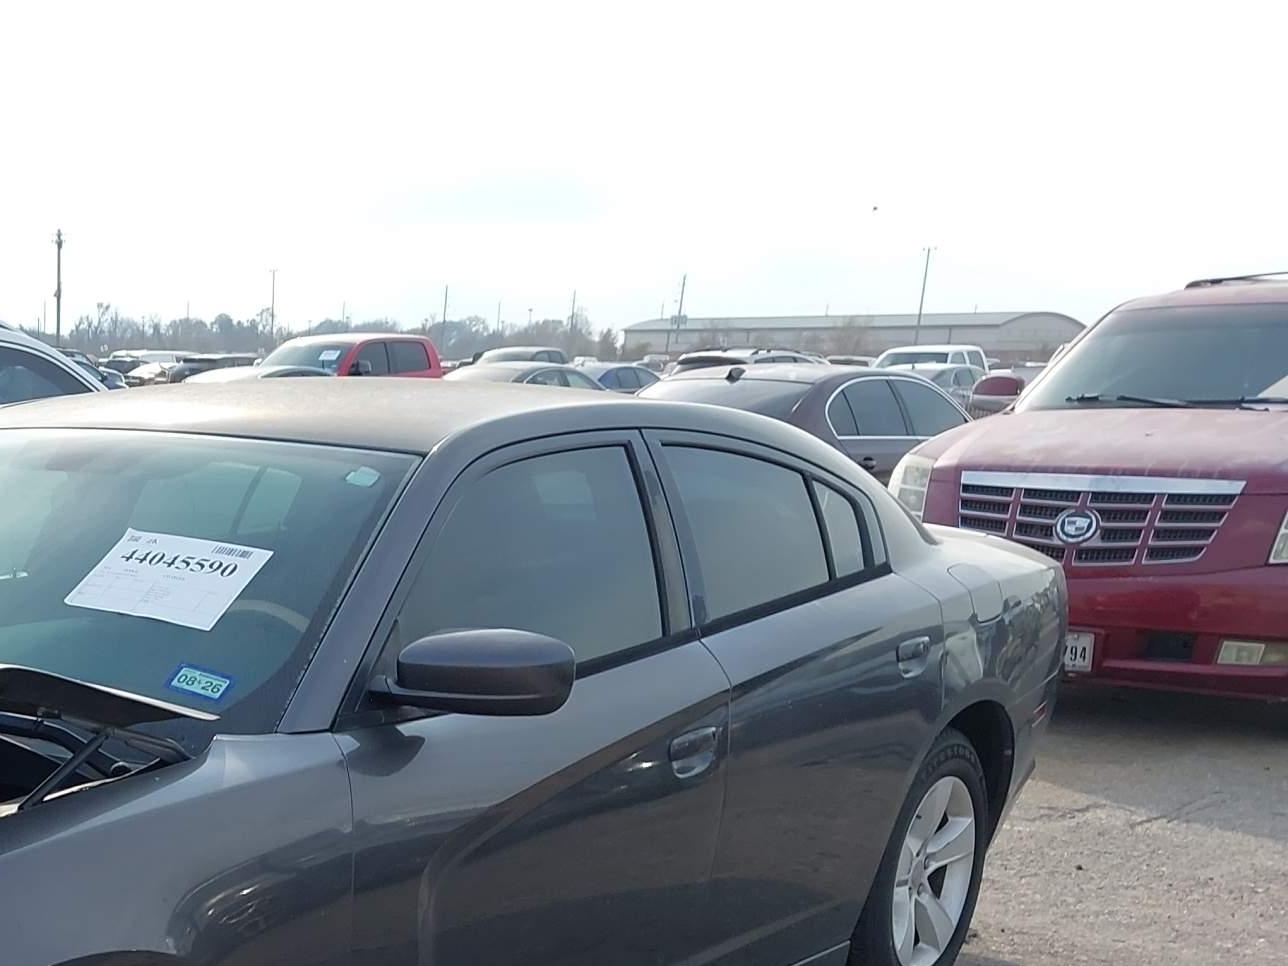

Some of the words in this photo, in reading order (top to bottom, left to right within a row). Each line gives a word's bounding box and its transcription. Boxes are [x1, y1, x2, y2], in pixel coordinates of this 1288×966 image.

[121, 549, 238, 577] 44045590
[177, 674, 197, 686] 08
[201, 681, 223, 694] 26
